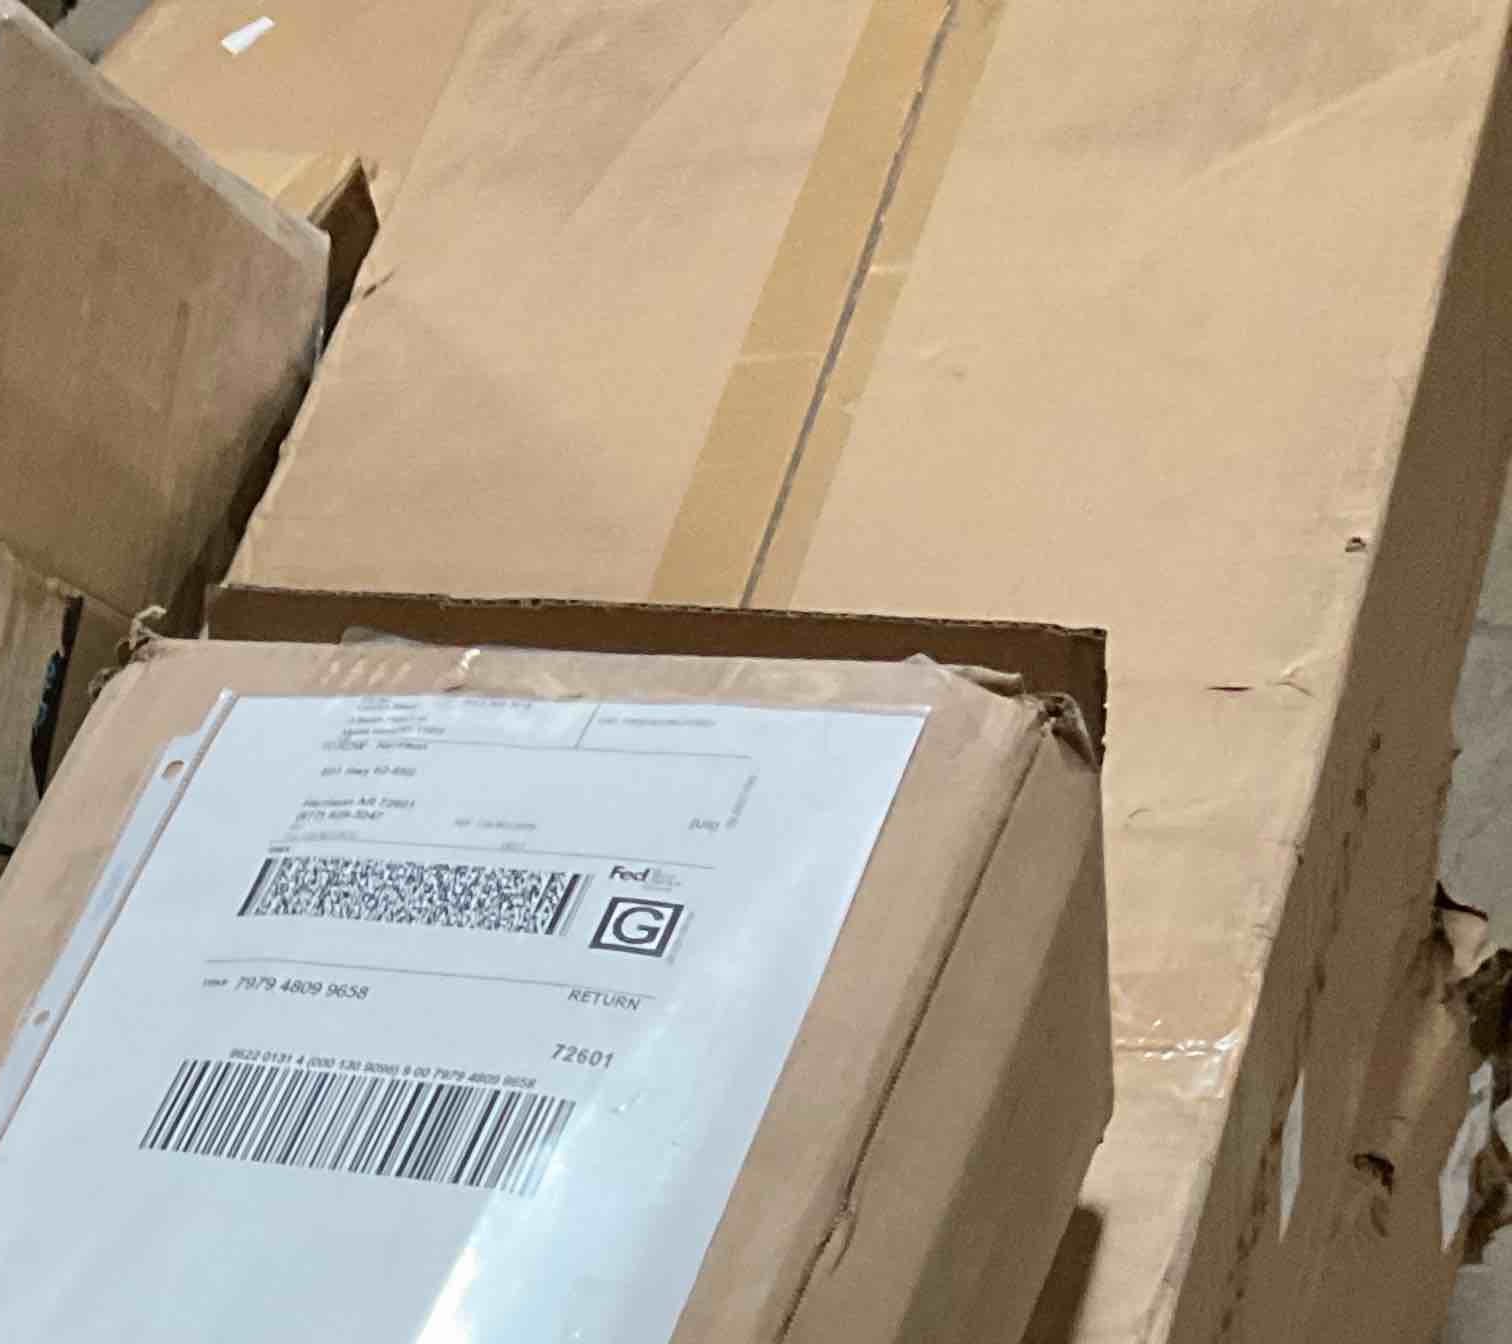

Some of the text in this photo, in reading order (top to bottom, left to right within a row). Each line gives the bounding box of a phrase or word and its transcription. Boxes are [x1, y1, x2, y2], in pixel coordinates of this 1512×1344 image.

[612, 906, 665, 944] G
[234, 975, 277, 991] 7979
[280, 977, 322, 995] 4809
[325, 983, 369, 1001] 9658
[568, 988, 641, 1011] RETURN
[551, 1042, 615, 1069] 72601
